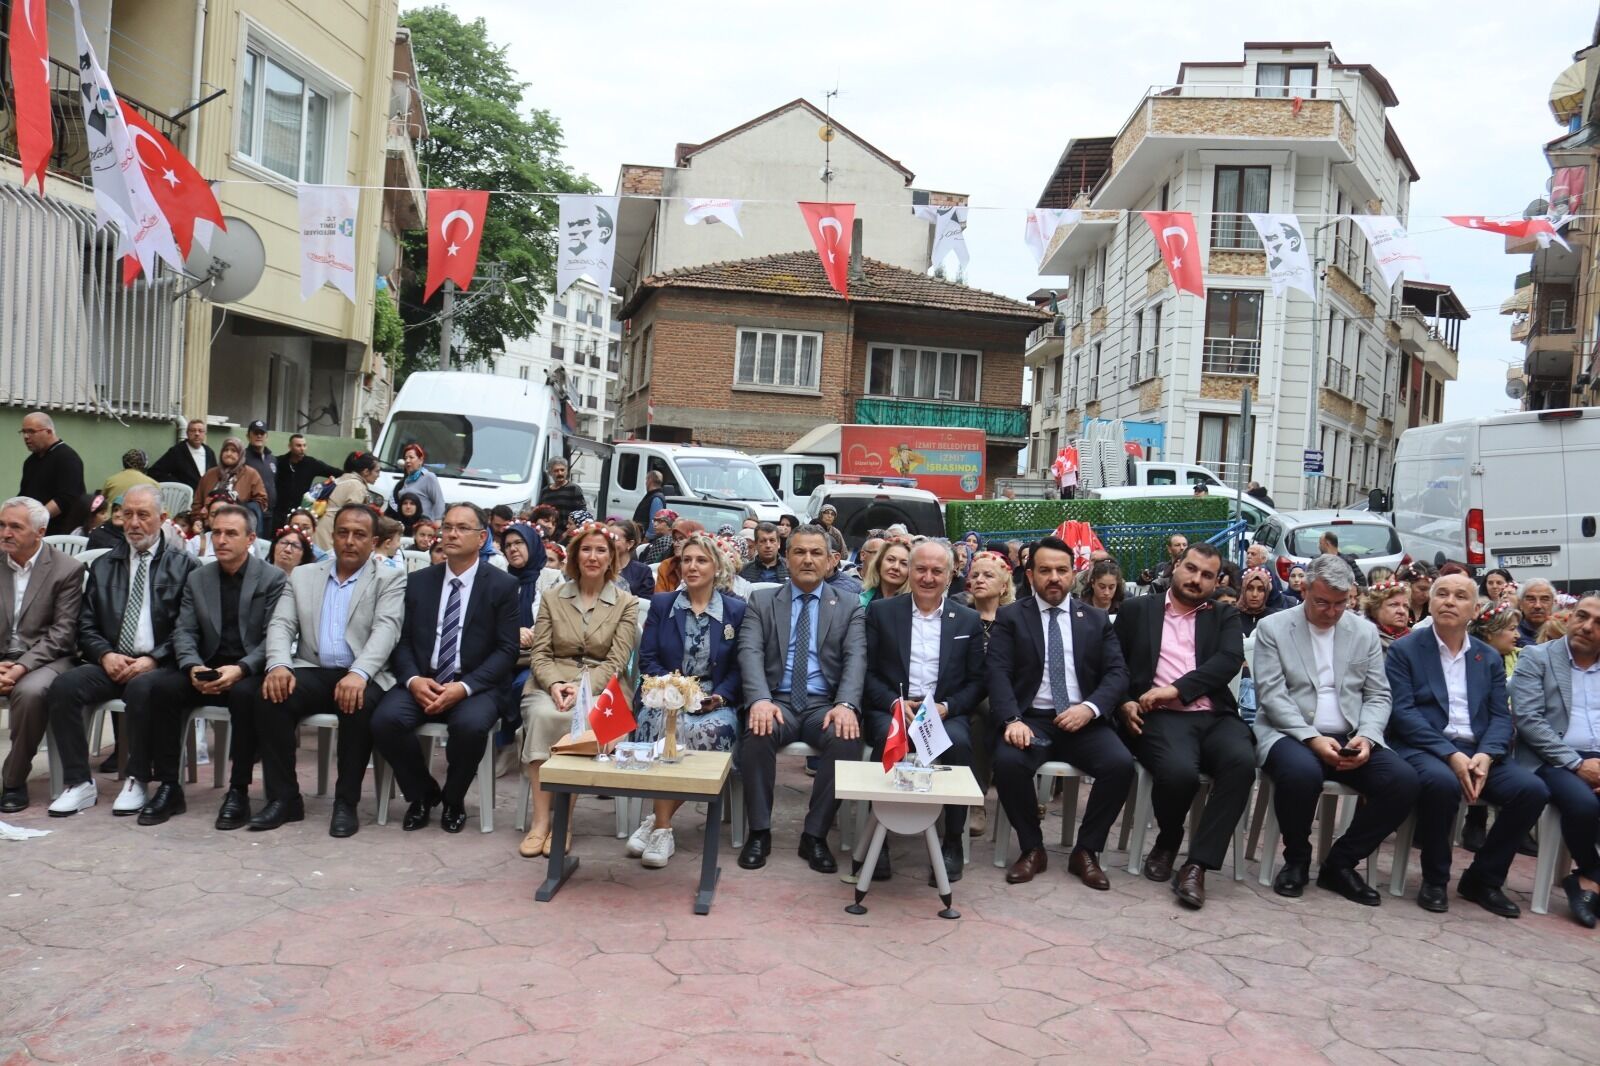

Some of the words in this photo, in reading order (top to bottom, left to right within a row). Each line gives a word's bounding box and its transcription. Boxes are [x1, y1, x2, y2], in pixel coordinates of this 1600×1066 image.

[915, 440, 937, 449] İZMİT
[938, 441, 979, 451] BELEDİYESİ
[940, 453, 966, 462] İZMİT
[926, 463, 978, 473] İŞBAŞINDA
[1495, 528, 1557, 536] PEUGEOT
[1503, 556, 1513, 564] 41
[1534, 554, 1549, 563] 439
[923, 722, 931, 738] İZMİT
[918, 726, 933, 757] BELEDİYESİ
